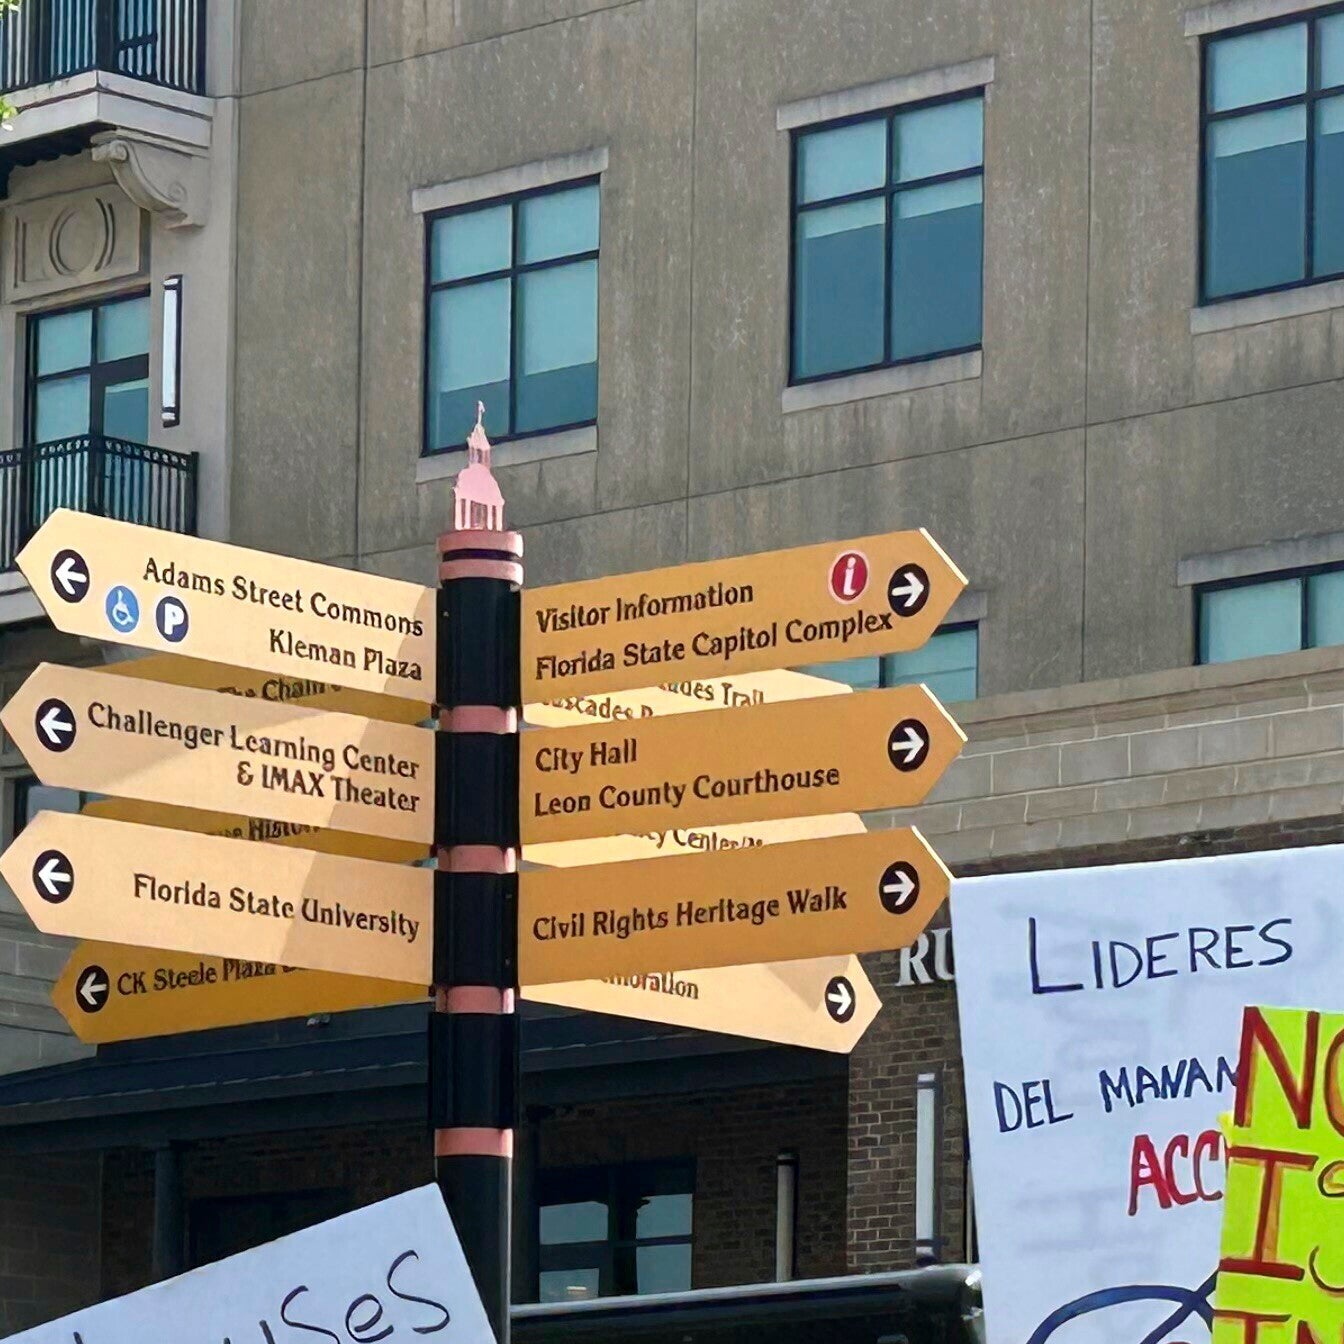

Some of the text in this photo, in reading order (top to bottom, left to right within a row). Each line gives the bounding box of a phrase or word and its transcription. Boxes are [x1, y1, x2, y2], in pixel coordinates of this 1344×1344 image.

[143, 557, 424, 637] Adams Street Commons
[536, 582, 754, 634] Visitor Information
[270, 629, 423, 681] Kleman Plaza
[536, 610, 893, 680] Florida State Capitol Complex
[87, 702, 420, 779] Challenger Learning Center
[535, 738, 638, 773] City Hall
[236, 761, 421, 813] & IMAX Theater
[534, 768, 840, 817] Leon County Courthouse
[133, 873, 420, 943] Florida State University
[533, 886, 848, 940] Civil Rights Heritage Walk
[117, 970, 148, 996] CK
[153, 961, 217, 991] Steele
[1027, 917, 1293, 995] LIDERES
[993, 1079, 1074, 1133] DEL
